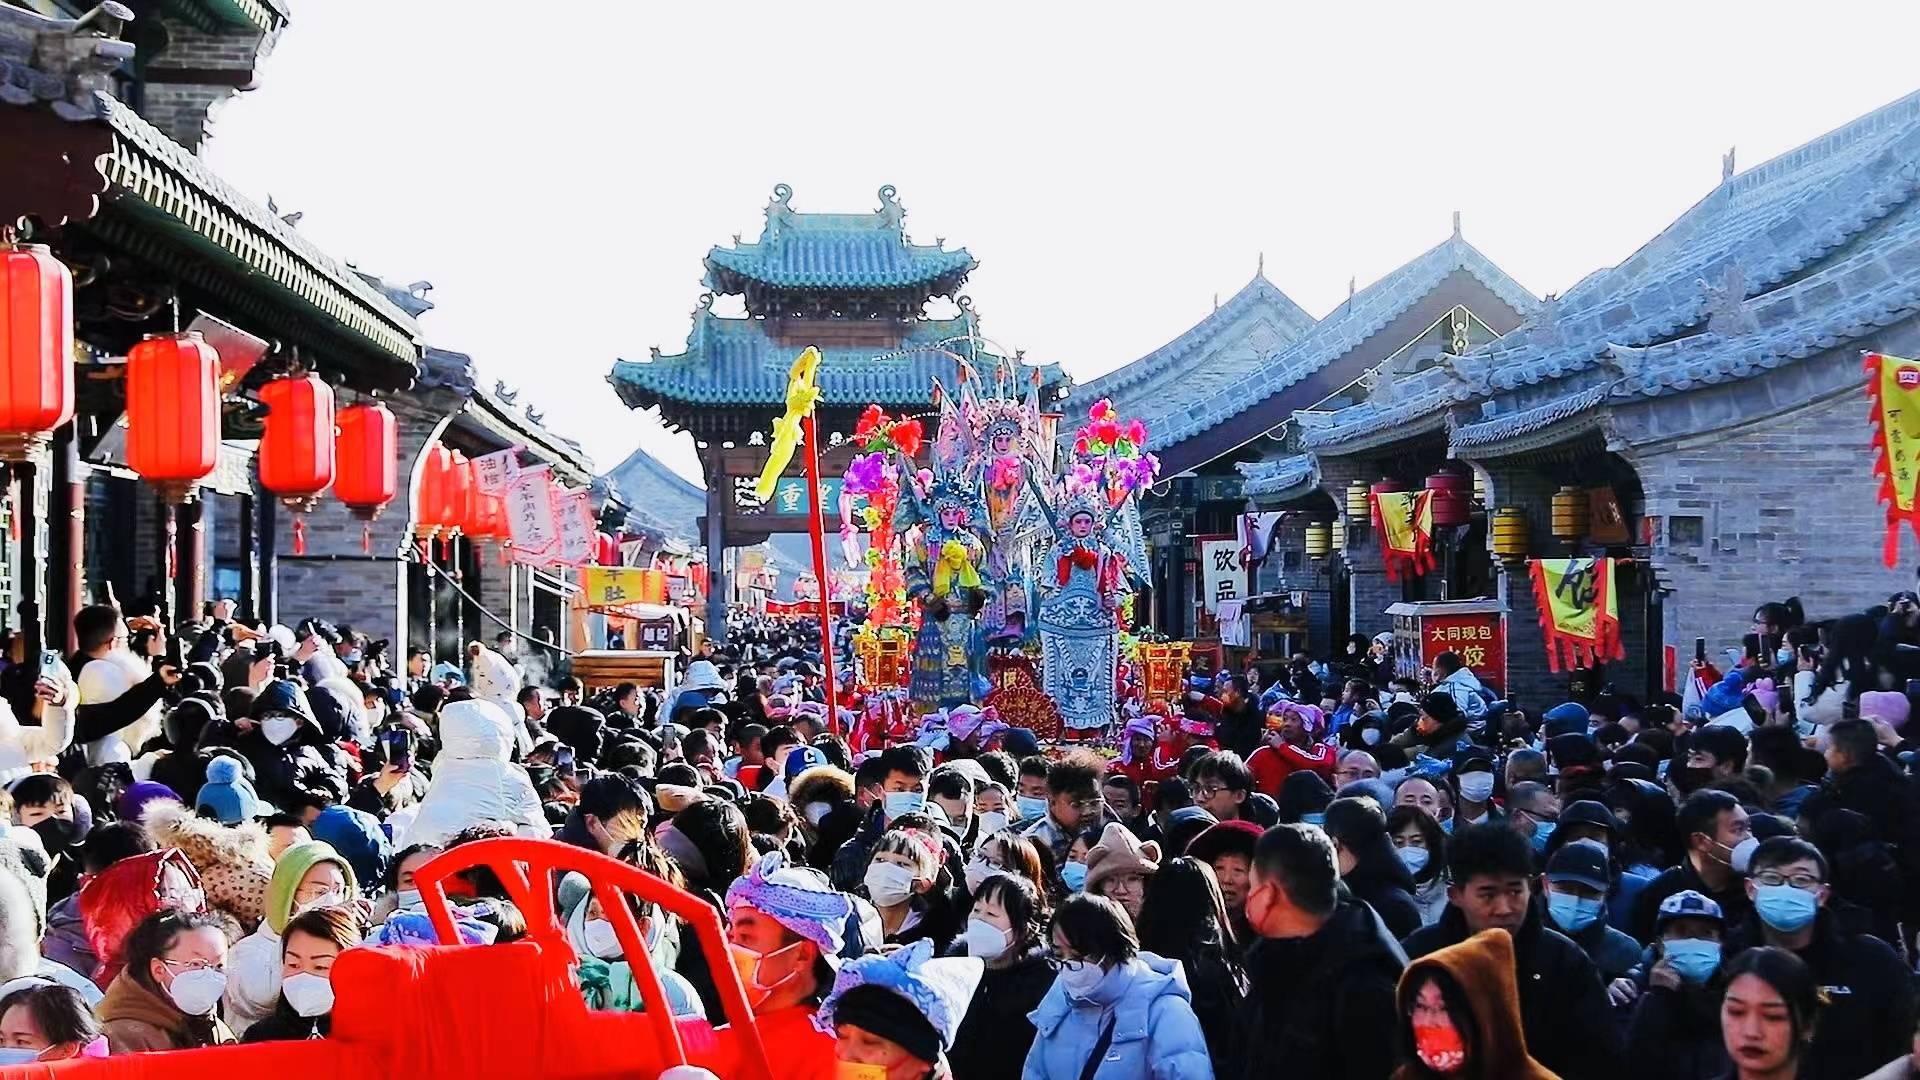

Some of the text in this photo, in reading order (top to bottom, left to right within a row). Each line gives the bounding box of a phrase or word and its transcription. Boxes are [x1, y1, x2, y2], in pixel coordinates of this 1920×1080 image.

[1213, 548, 1238, 602] 饮品
[1431, 626, 1492, 641] 大同现包
